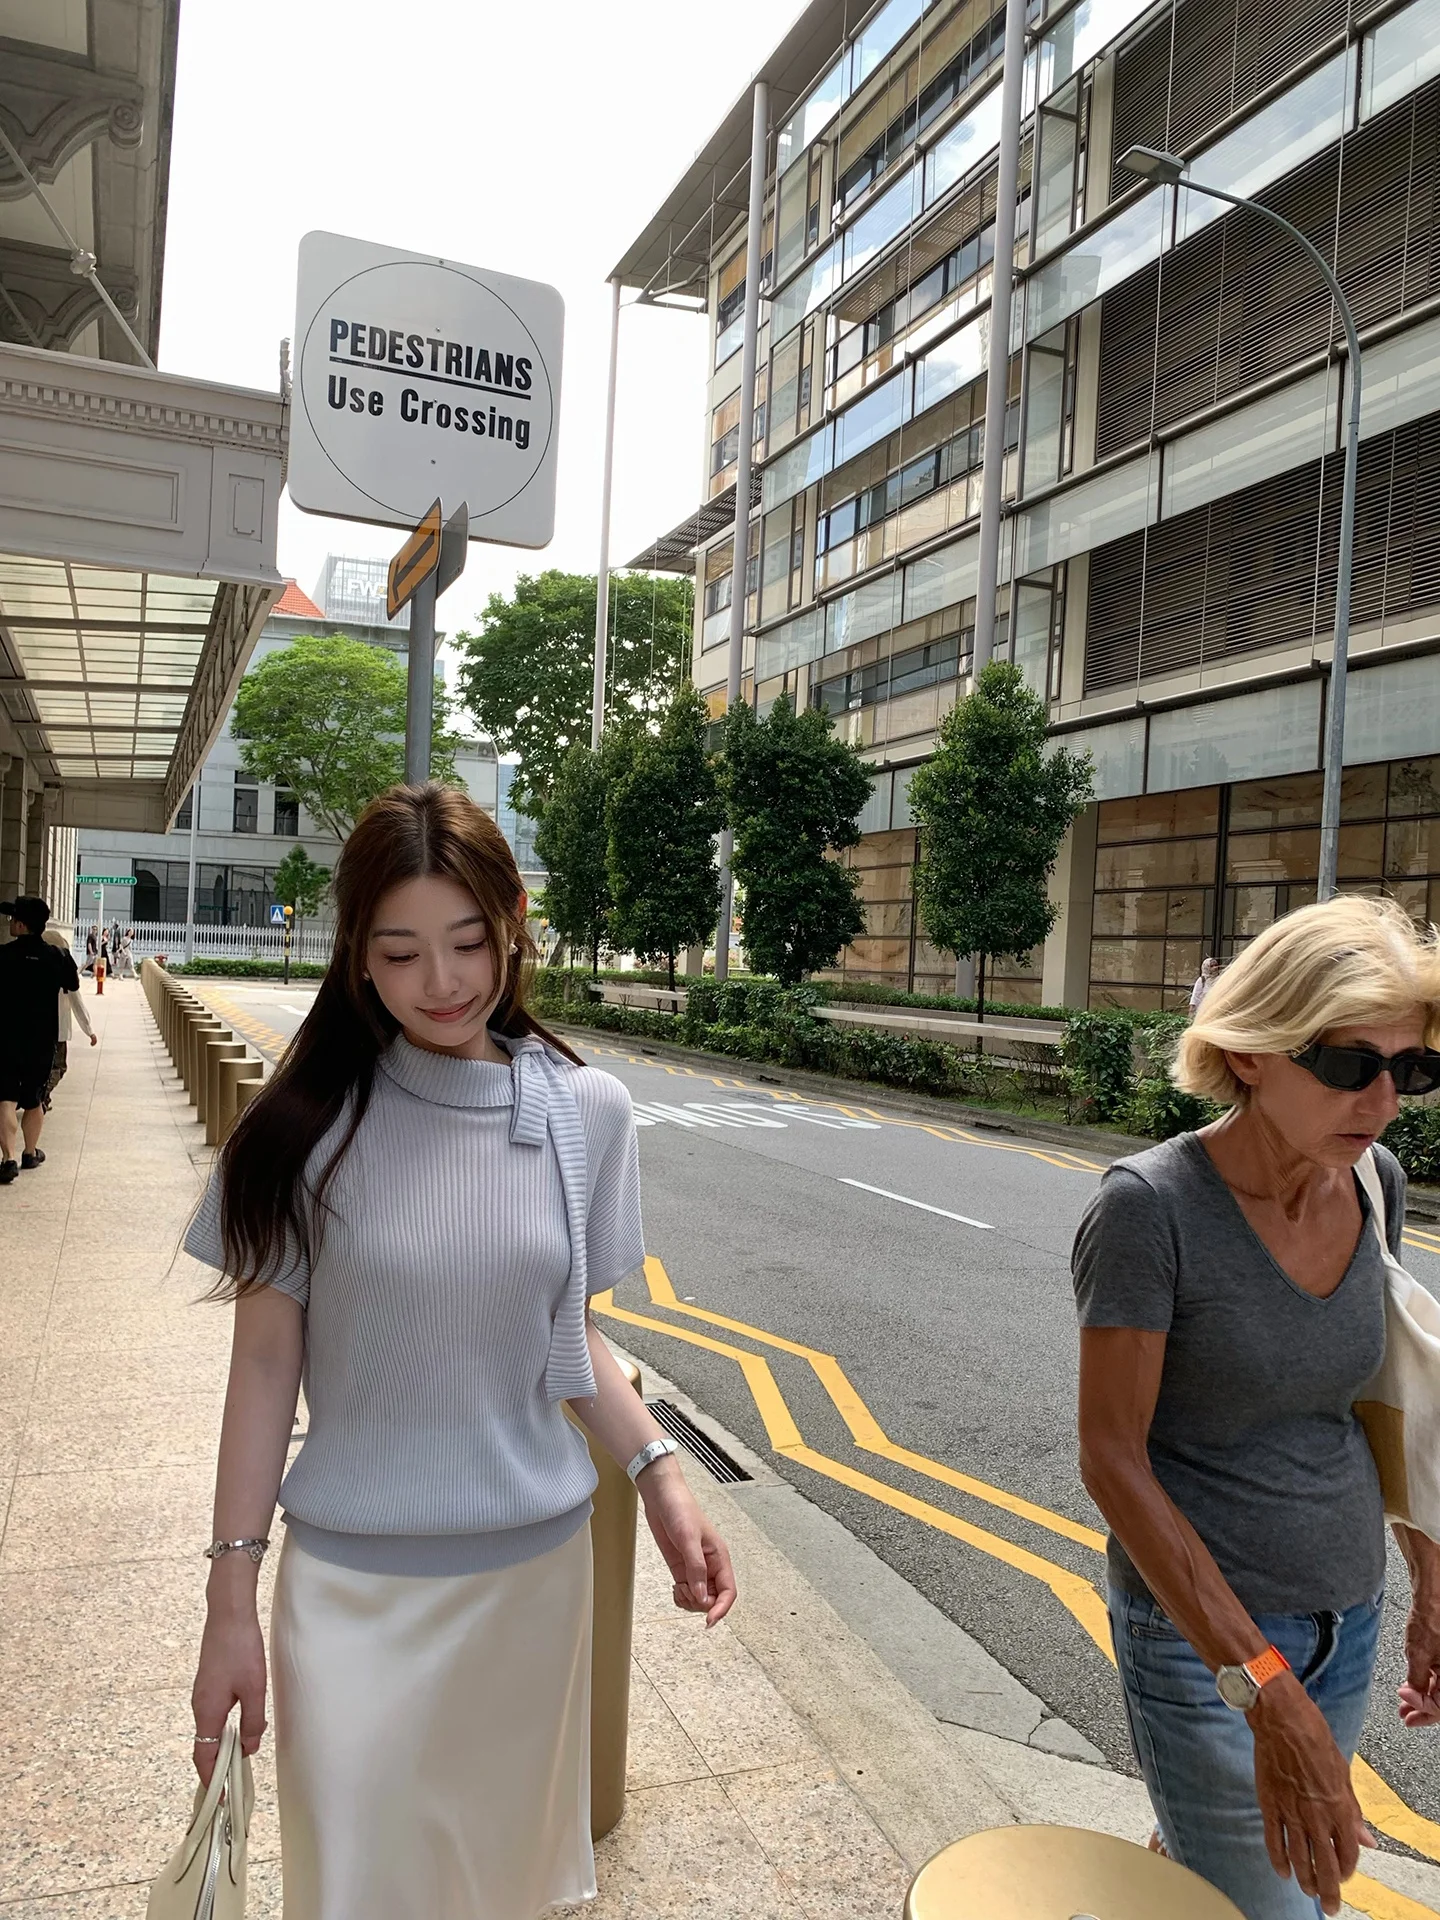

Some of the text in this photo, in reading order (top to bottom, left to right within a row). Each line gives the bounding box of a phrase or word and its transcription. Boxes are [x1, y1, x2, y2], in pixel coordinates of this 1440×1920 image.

[329, 318, 533, 391] PEDESTRIANS
[327, 374, 530, 450] Use Crossing
